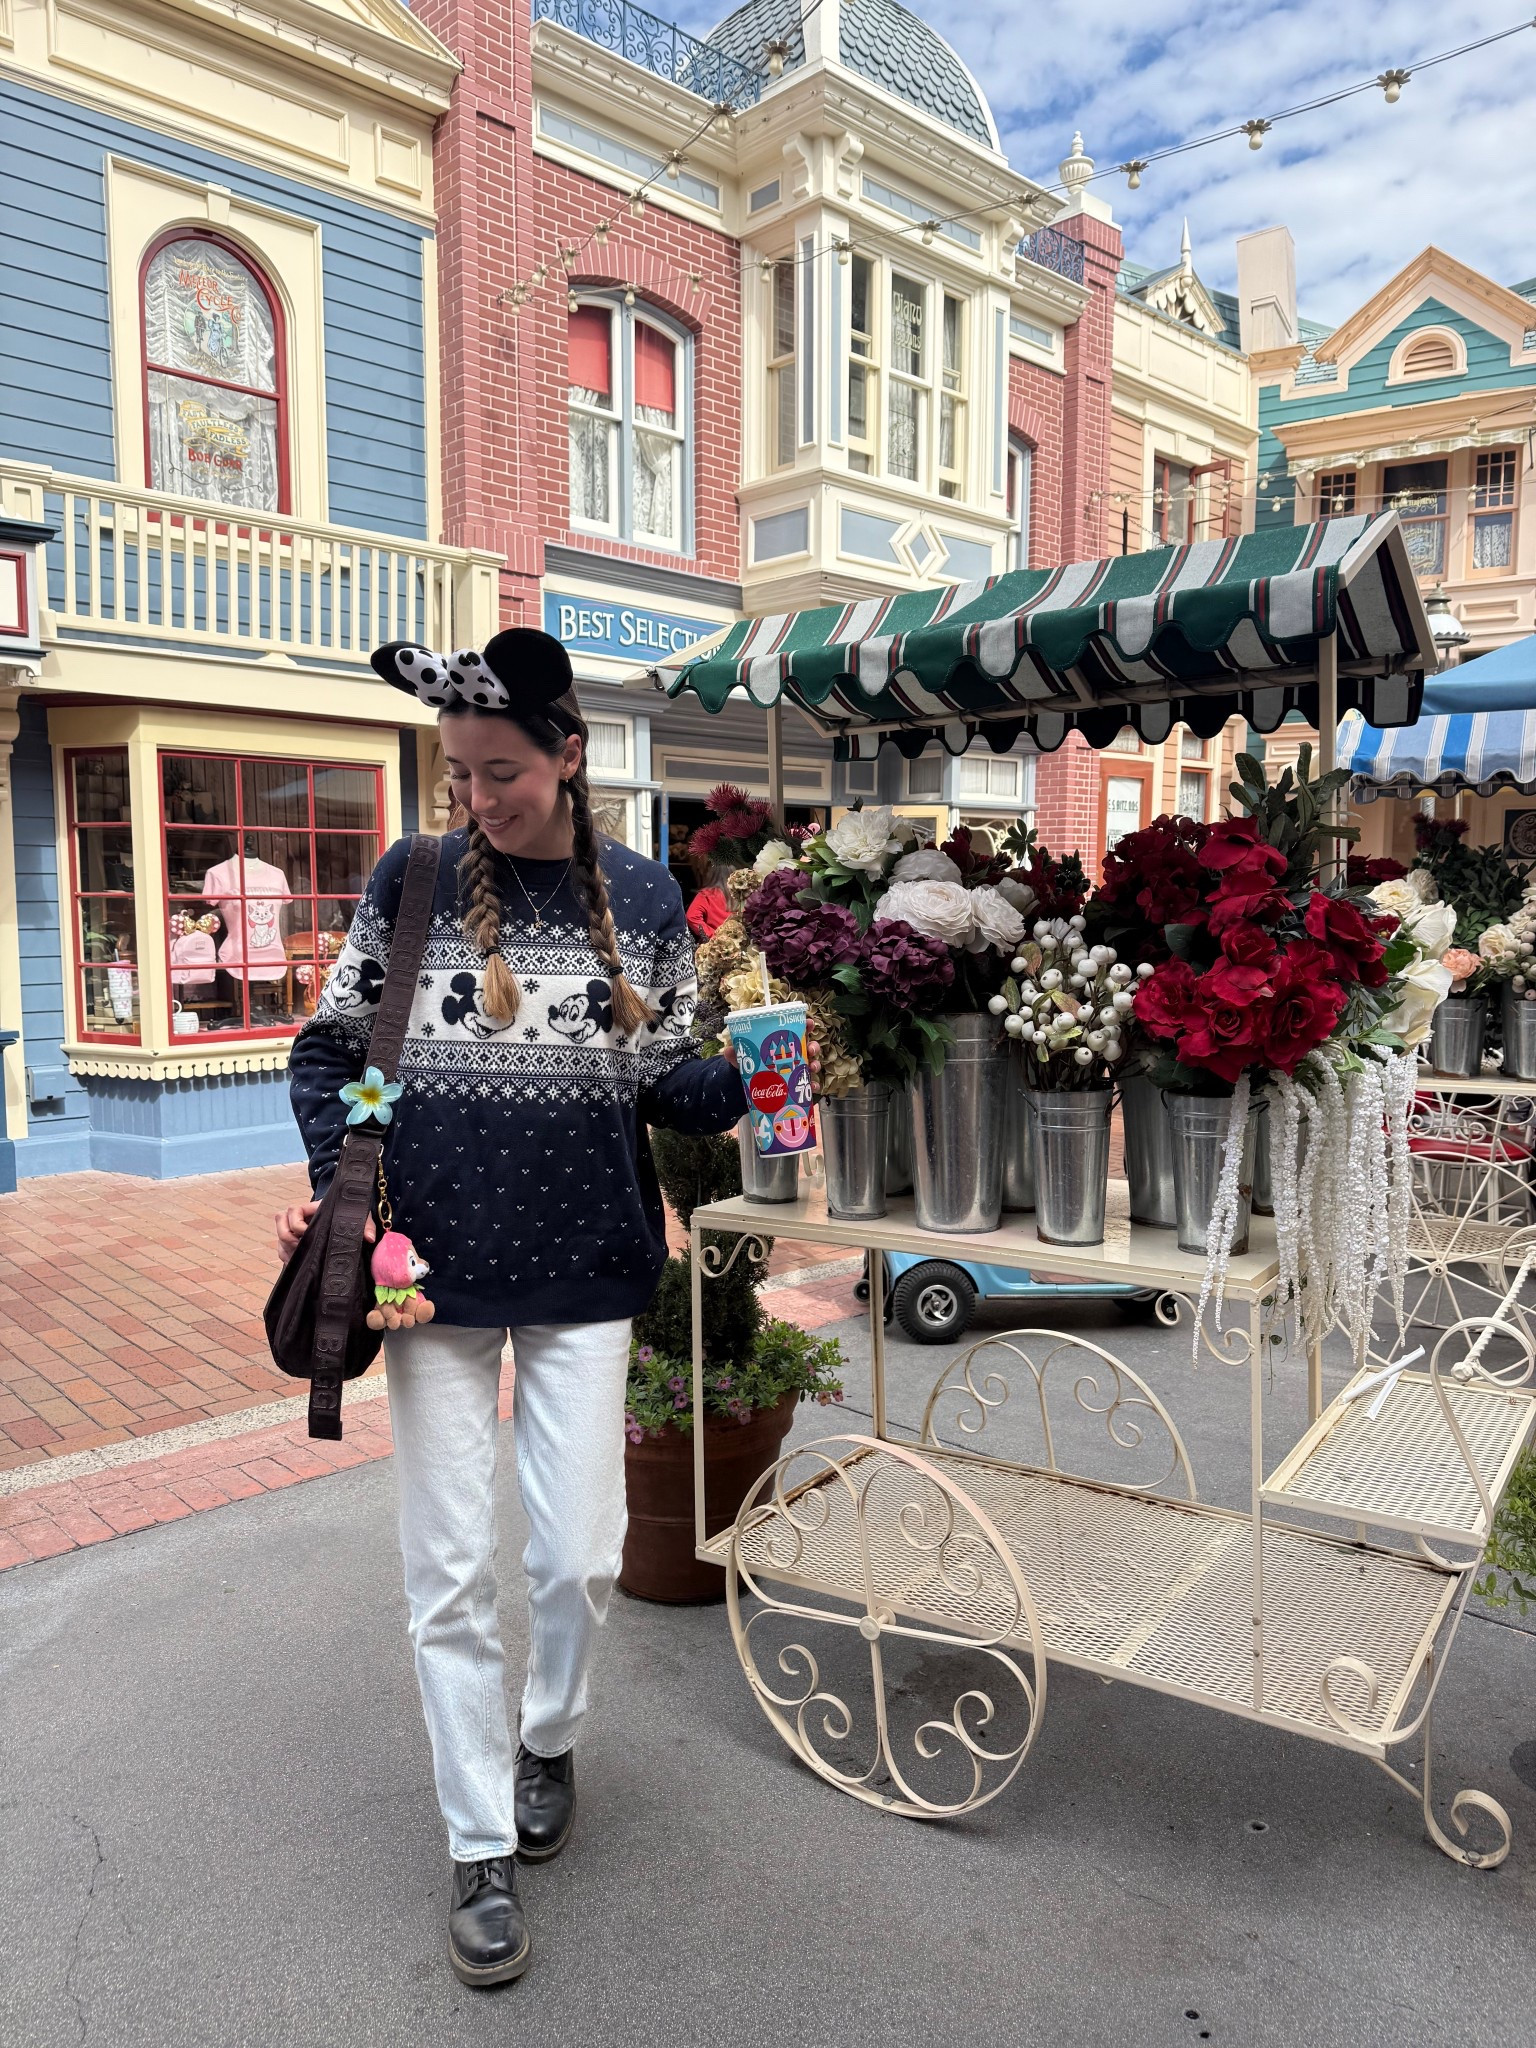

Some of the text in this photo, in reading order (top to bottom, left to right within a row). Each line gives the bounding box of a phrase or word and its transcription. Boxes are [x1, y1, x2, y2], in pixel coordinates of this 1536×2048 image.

[196, 281, 233, 311] CYCLE
[191, 419, 239, 433] FAULTLESS
[209, 431, 247, 445] FADLESS
[559, 604, 615, 641] BEST
[751, 1083, 785, 1100] Coca-Cola
[795, 1083, 812, 1104] 70
